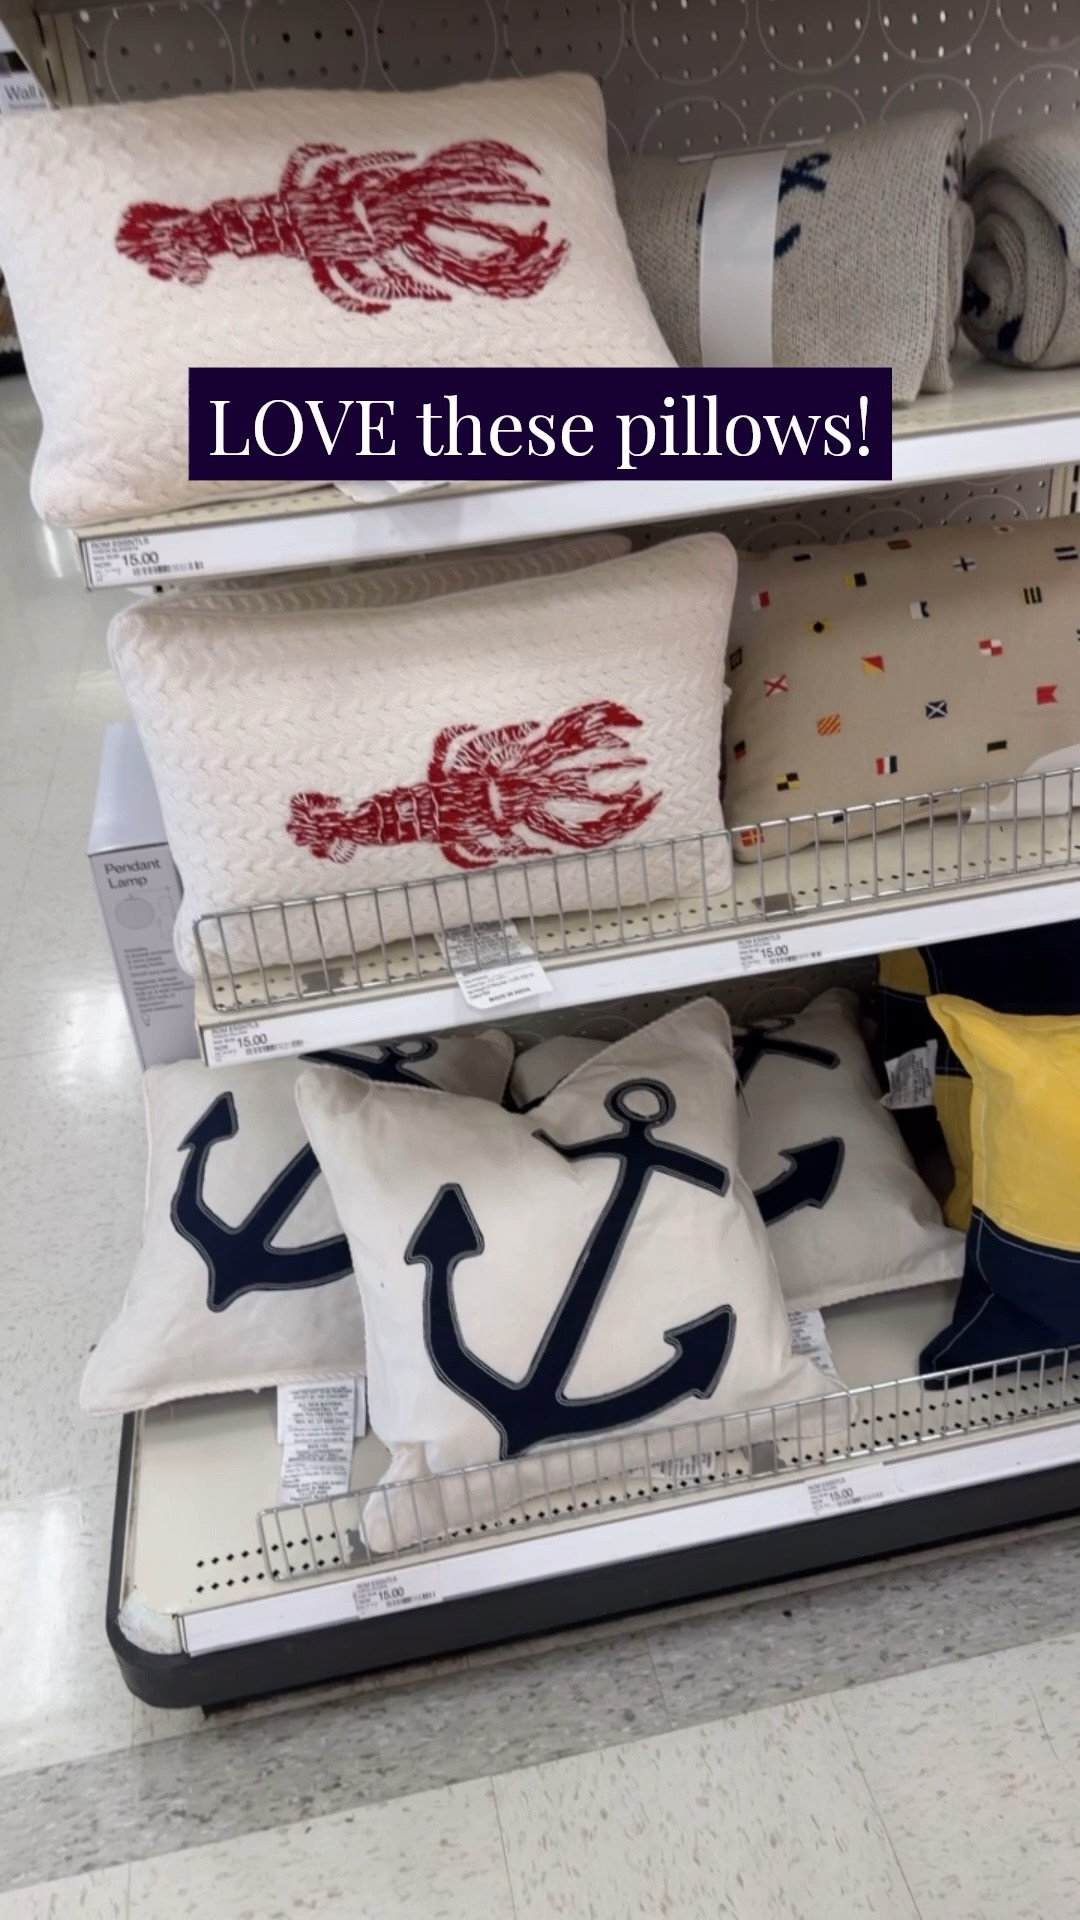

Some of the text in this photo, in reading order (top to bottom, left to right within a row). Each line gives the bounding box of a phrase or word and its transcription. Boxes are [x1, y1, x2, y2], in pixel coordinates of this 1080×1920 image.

[4, 84, 37, 101] Wall
[123, 551, 159, 567] 15.00
[104, 858, 162, 875] Pendant
[107, 875, 148, 890] Lamp
[761, 944, 789, 959] 15.00
[237, 1033, 268, 1049] 15.00
[829, 1487, 854, 1503] 15.00
[379, 1586, 405, 1602] 15.00
